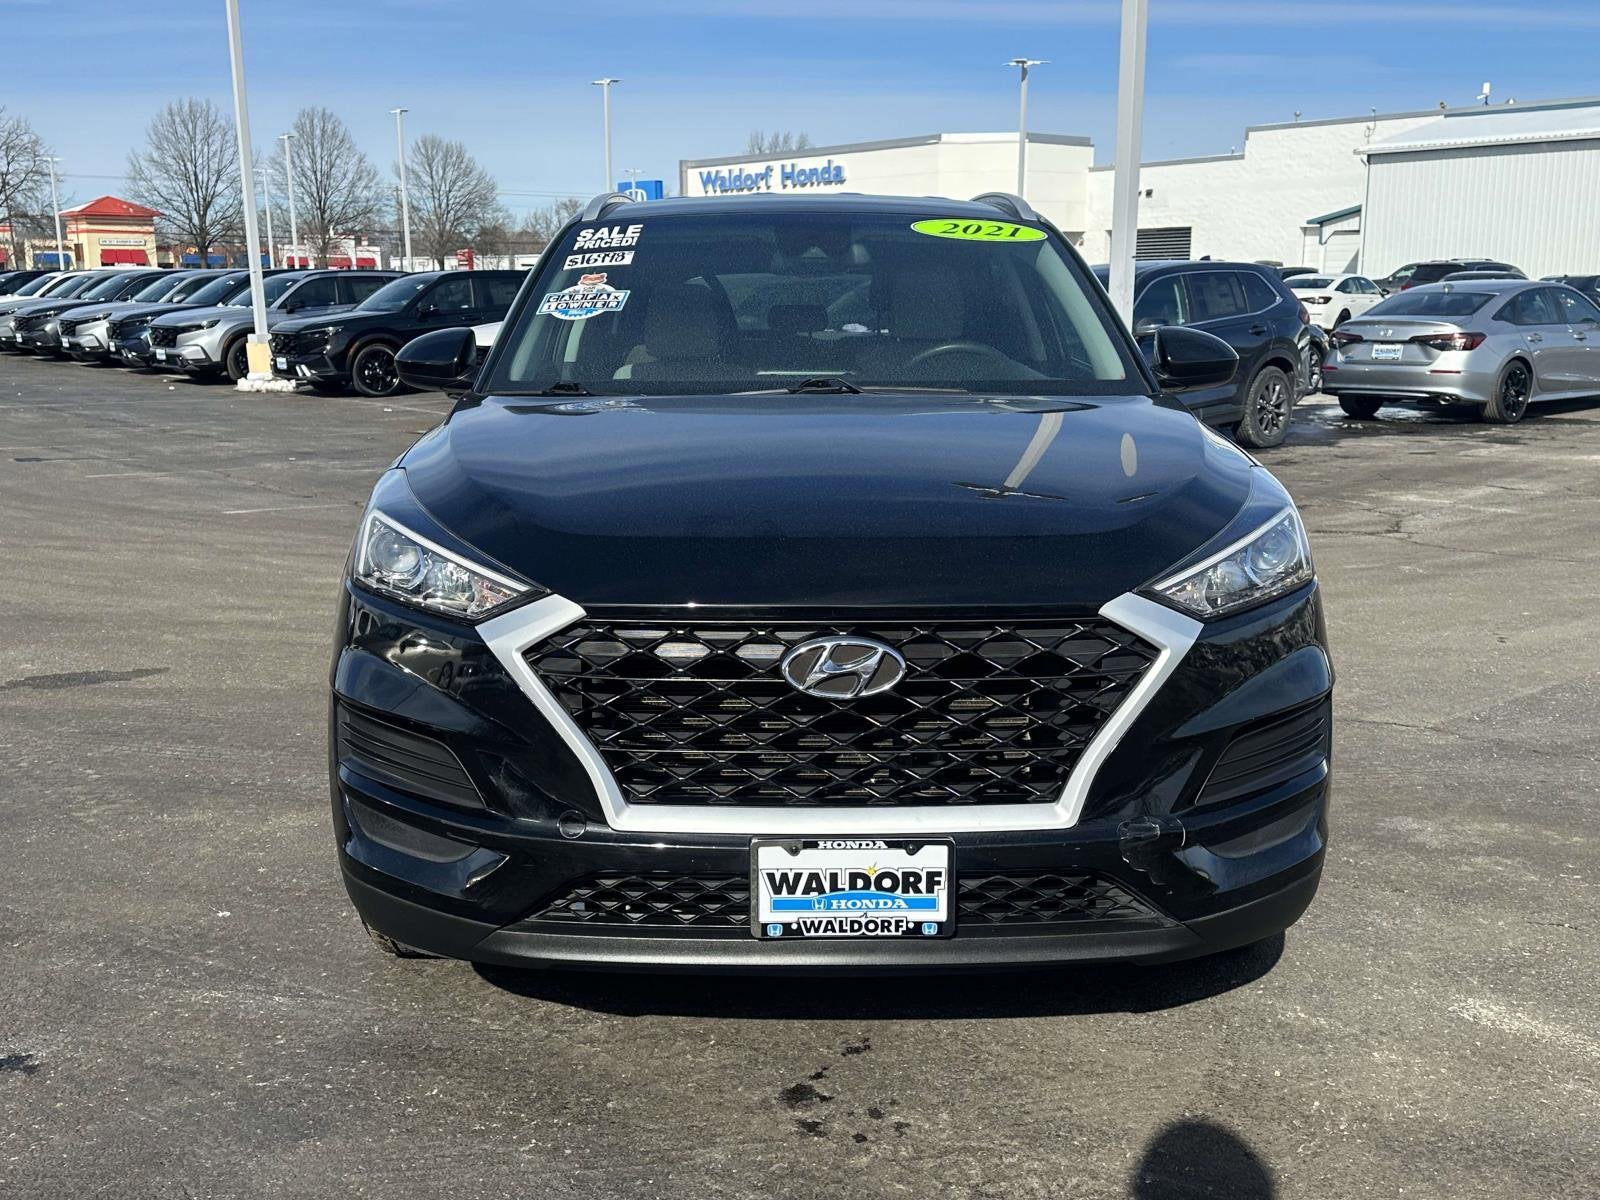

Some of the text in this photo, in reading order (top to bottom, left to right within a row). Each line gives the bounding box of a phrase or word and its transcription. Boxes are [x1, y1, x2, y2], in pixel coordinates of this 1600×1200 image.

[699, 160, 846, 192] Waldorf Honda
[577, 224, 644, 241] SALE
[940, 222, 1021, 238] 2021
[573, 236, 638, 250] PRICED!
[548, 293, 621, 302] CARFAX
[557, 301, 618, 310] OWNER
[817, 840, 888, 849] HONDA
[765, 871, 943, 896] WALDORF
[830, 899, 909, 910] HONDA
[801, 918, 907, 935] WALDORF
